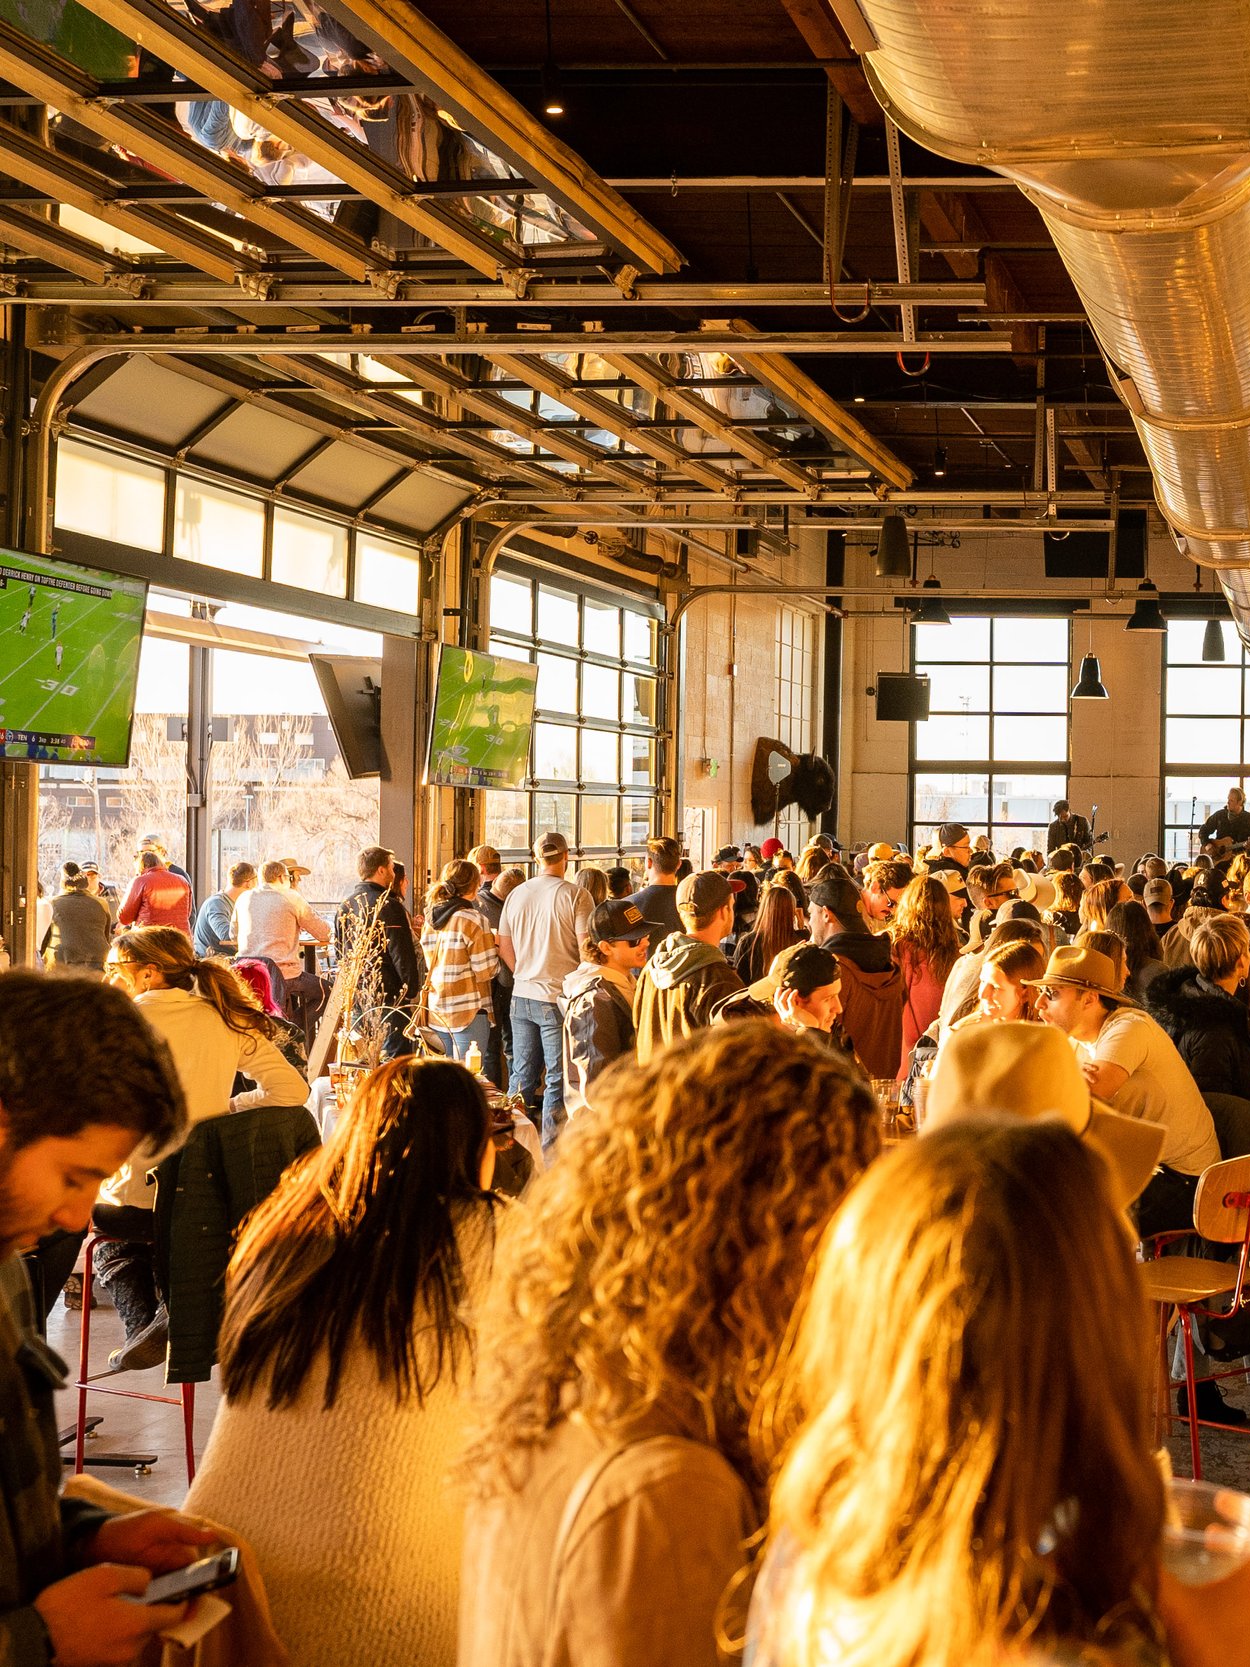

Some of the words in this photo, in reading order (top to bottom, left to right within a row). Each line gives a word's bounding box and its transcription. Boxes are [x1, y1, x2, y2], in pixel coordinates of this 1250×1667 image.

[3, 568, 21, 580] DERRICK
[21, 572, 34, 582] HENRY
[34, 575, 41, 583] ON
[56, 579, 75, 590] DEFENDER
[75, 583, 90, 593] BEFORE
[90, 587, 102, 596] GOING
